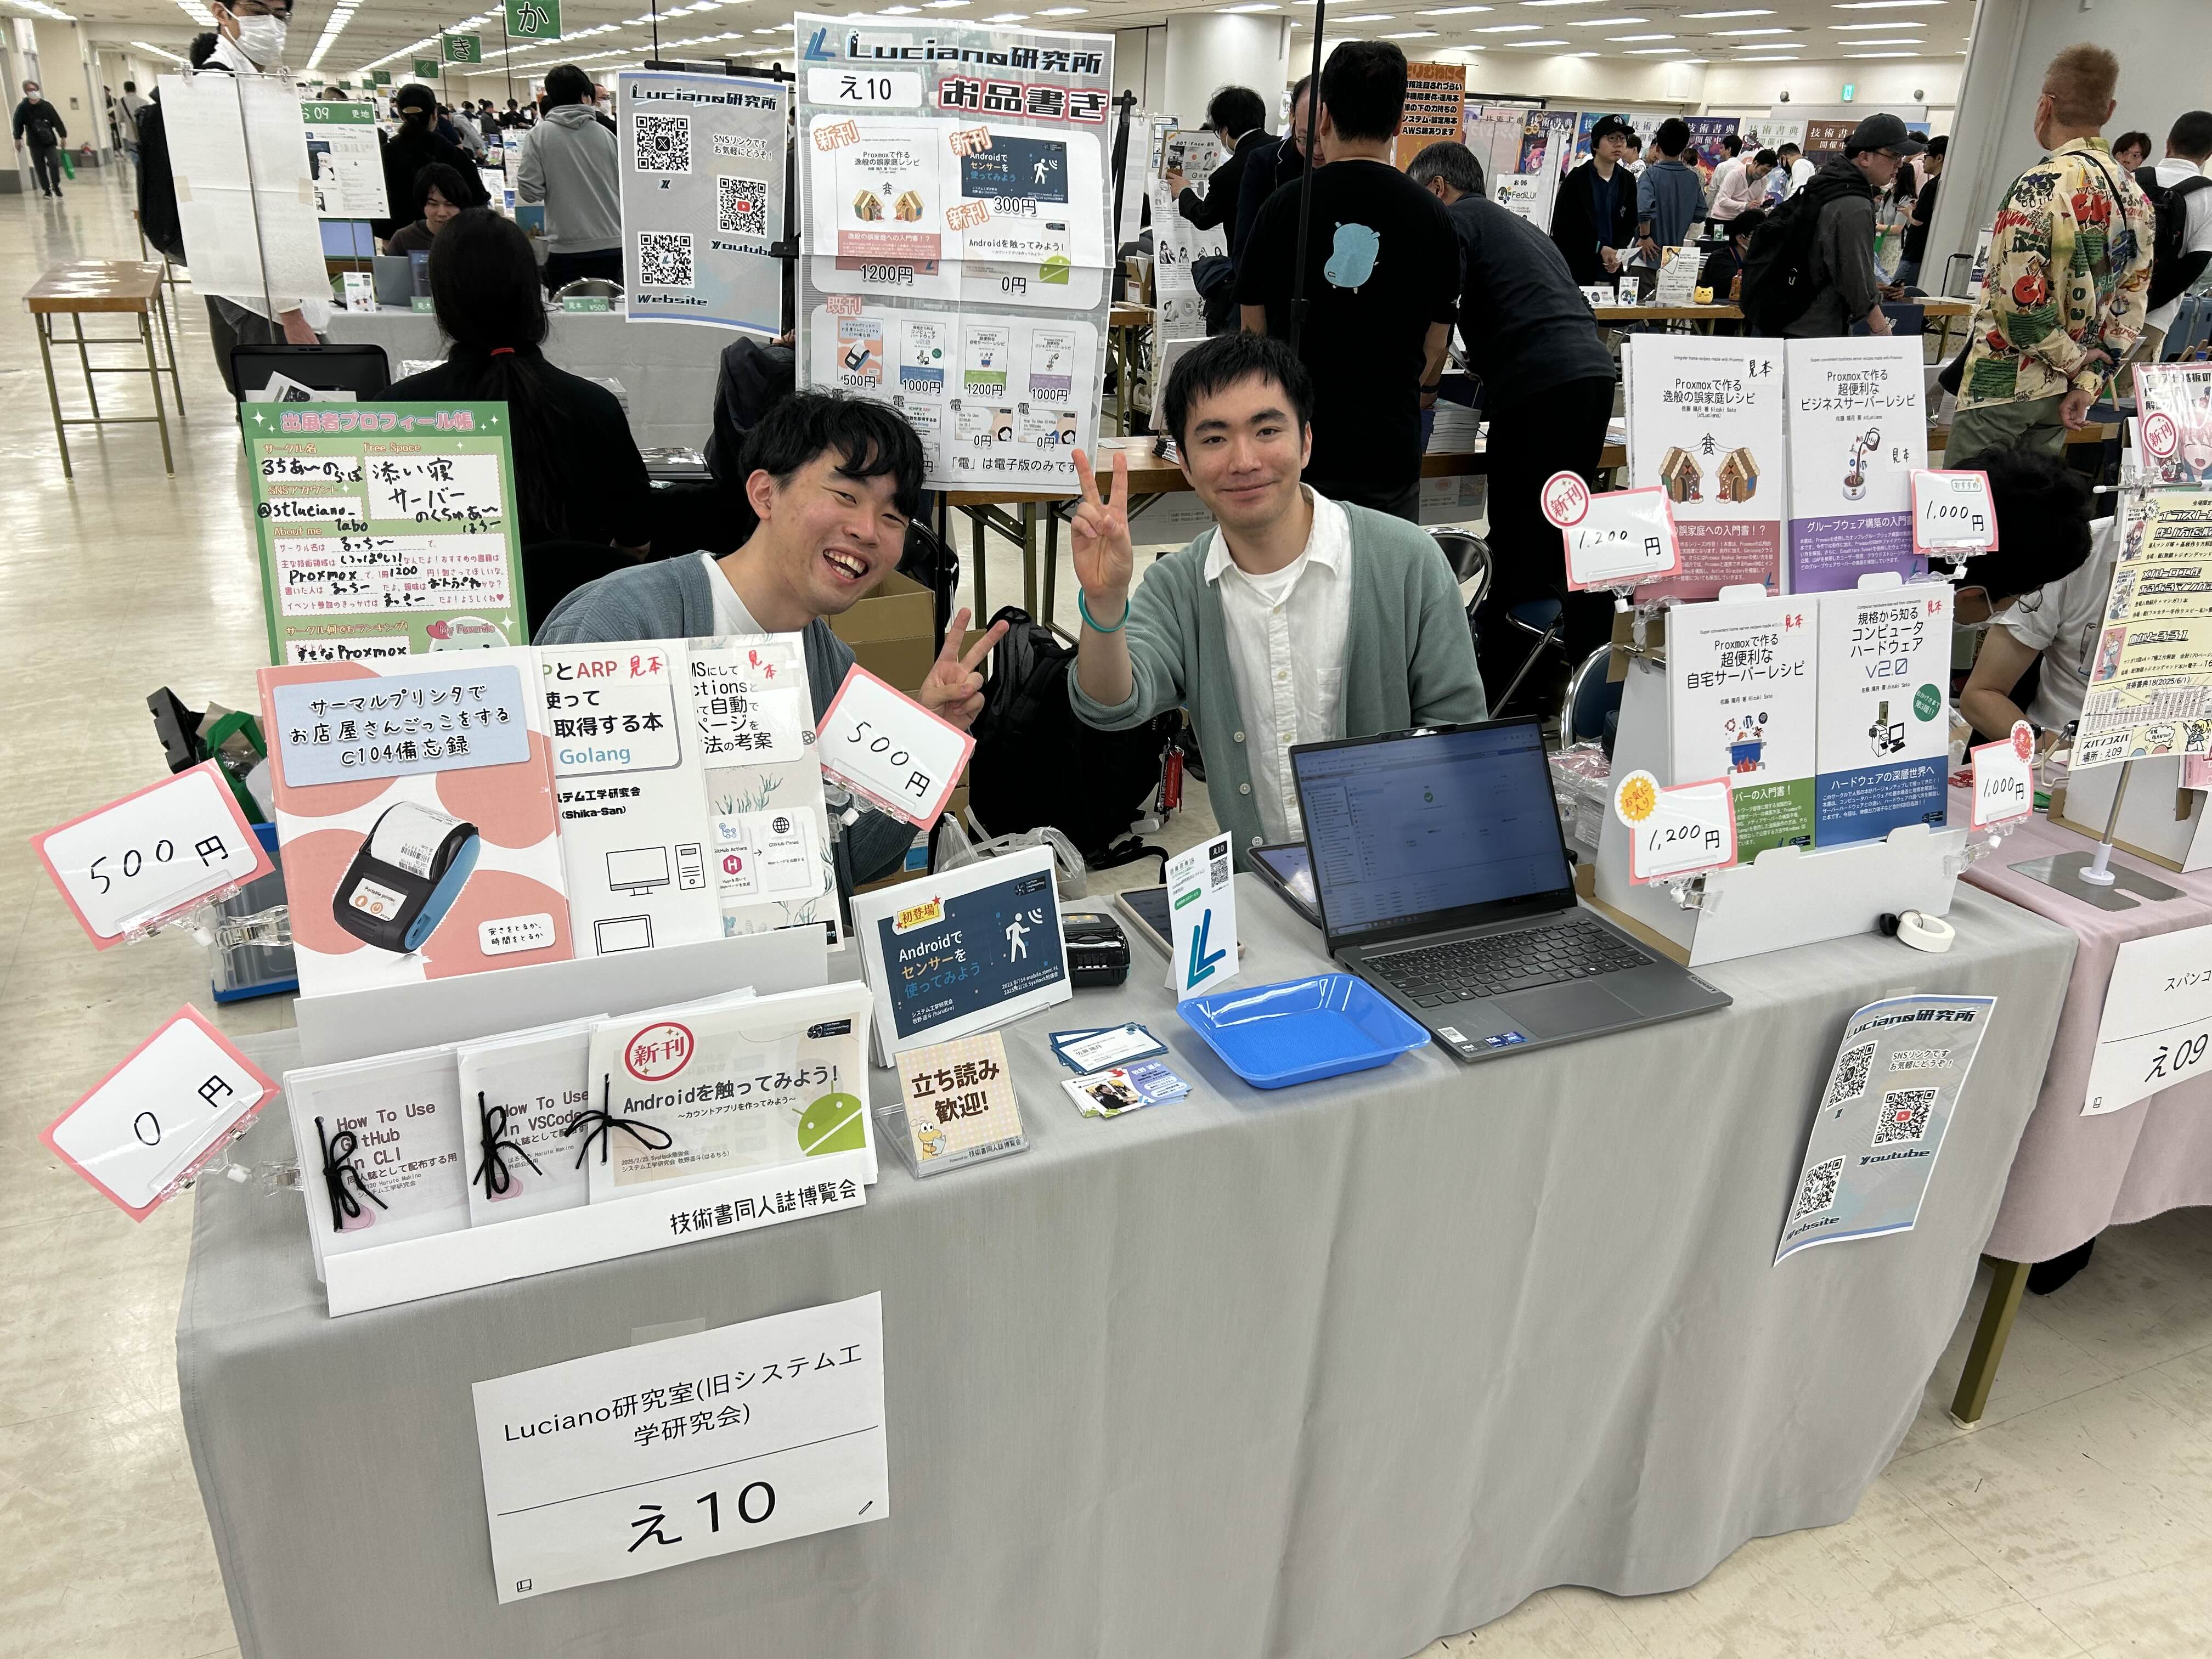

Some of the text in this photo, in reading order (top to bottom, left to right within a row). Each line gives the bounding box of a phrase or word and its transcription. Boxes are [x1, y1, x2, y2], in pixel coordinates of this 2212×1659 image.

[517, 1, 549, 33] か
[452, 37, 471, 60] き
[845, 30, 1103, 75] Luciano研究所
[421, 62, 430, 76] く
[631, 82, 778, 111] Luciano研究所
[839, 75, 891, 101] え10
[940, 77, 1109, 123] お品書き
[314, 107, 329, 120] 09
[814, 121, 860, 151] 新刊
[1687, 122, 1735, 134] 技術書典
[1748, 123, 1800, 136] 技術書典
[713, 134, 768, 149] SNSリンクです
[950, 127, 991, 156] 新刊
[969, 152, 1008, 162] Androidで
[970, 162, 1008, 172] センサーを
[970, 171, 1016, 182] 使ってみよう
[946, 200, 990, 231] 新刊
[994, 197, 1037, 216] 300円
[860, 264, 914, 285] 1200円
[1001, 276, 1027, 294] 0円
[637, 294, 708, 306] Website
[826, 296, 862, 315] 既刊
[1748, 359, 1773, 378] 見本
[1827, 369, 1888, 382] Proxmoxで作る
[843, 375, 877, 388] 500円
[902, 379, 941, 394] 1000円
[967, 383, 1003, 397] 1200円
[1675, 378, 1742, 391] Proxmoxで作る
[1838, 382, 1880, 396] 超便利な
[1032, 388, 1068, 402] 1000円
[1663, 390, 1756, 404] 逸般の誤家庭レシピ
[1802, 394, 1916, 411] ビジネスサーバーレシピ
[281, 410, 476, 433] 出展者プロフィール帳
[974, 435, 992, 447] 0円
[1036, 437, 1055, 449] 0円
[2148, 421, 2172, 448] 新刊
[263, 443, 318, 454] サークル名
[364, 442, 421, 454] Free Space
[1892, 446, 1911, 464] 見本
[268, 484, 339, 495] SNSアカウント
[388, 486, 466, 512] サーバー
[1550, 483, 1583, 519] 新刊
[274, 526, 323, 537] About me
[335, 518, 369, 532] labo
[1972, 515, 1984, 531] 円
[279, 544, 325, 552] サークル名は
[1644, 537, 1661, 556] 円
[281, 559, 336, 568] 主な技術領域は
[2142, 567, 2202, 579] メカトロ工作
[289, 566, 419, 586] Proxmox 1200
[284, 586, 323, 596] 書いた人は
[287, 599, 379, 610] イベント参加のきっかけは
[1928, 600, 1943, 617] 見本
[1785, 614, 1804, 632] 見本
[1858, 607, 1918, 626] 規格から知る
[439, 623, 496, 635] My Favorite
[1852, 621, 1924, 641] コンピュータ
[1714, 634, 1779, 651] Proxmoxで作る
[1850, 637, 1923, 658] ハードウェア
[629, 655, 664, 679] 見本
[748, 649, 777, 680] 見本
[1720, 647, 1774, 668] 超便利な
[1686, 660, 1805, 690] 自宅サーバーレシピ
[1865, 658, 1908, 679] v2.0
[2125, 676, 2191, 690] 技術書典18(2025/6/1)
[309, 684, 488, 718] サーマルプリンタで
[546, 689, 600, 711] 使って
[1915, 689, 1941, 709] おかげさまで
[289, 707, 511, 745] お店屋さんごっこをする
[554, 712, 664, 739] 取得する本
[340, 735, 471, 766] C104備忘録
[2083, 733, 2130, 749] スパンコスパ
[558, 746, 631, 765] Golang
[847, 721, 930, 797] 500 円
[1831, 766, 1935, 790] ハードウェアの深層世界へ
[1624, 785, 1649, 808] お気に
[2016, 783, 2024, 800] 円
[561, 806, 628, 820] (Shika-San)
[1634, 797, 1650, 816] 入り
[1649, 825, 1720, 851] 1,200 円
[90, 834, 229, 895] 500 円
[364, 885, 382, 897] Portable
[902, 903, 935, 924] 初登場
[488, 921, 544, 936] 安さをとるか、
[491, 933, 545, 946] 時間をとるか
[898, 930, 963, 963] Androidで
[901, 948, 967, 980] センサーを
[904, 961, 981, 1000] 使ってみよう
[911, 998, 954, 1018] システム工学研究会
[1846, 1008, 1978, 1040] Luciano研究所
[633, 1036, 685, 1068] 新刊
[1892, 1049, 1950, 1061] SNSリンクです
[2144, 1033, 2209, 1084] え09
[911, 1058, 1001, 1099] 立ち読み
[623, 1064, 838, 1115] Androidを触ってみよう!
[535, 1090, 589, 1110] To Use
[934, 1091, 990, 1124] 歓迎!
[134, 1074, 234, 1146] 0 円
[336, 1102, 436, 1132] How To Use
[527, 1109, 583, 1131] VSCode
[373, 1146, 402, 1165] CLI
[1859, 1148, 1931, 1166] Youtube
[622, 1159, 675, 1172] システム工学研究会
[669, 1178, 857, 1235] 技術書同人誌博覧会
[1786, 1216, 1840, 1242] Website
[503, 1342, 864, 1443] Luciano研究室(旧システム工
[633, 1402, 752, 1448] 学研究会)
[626, 1479, 777, 1553] え10
